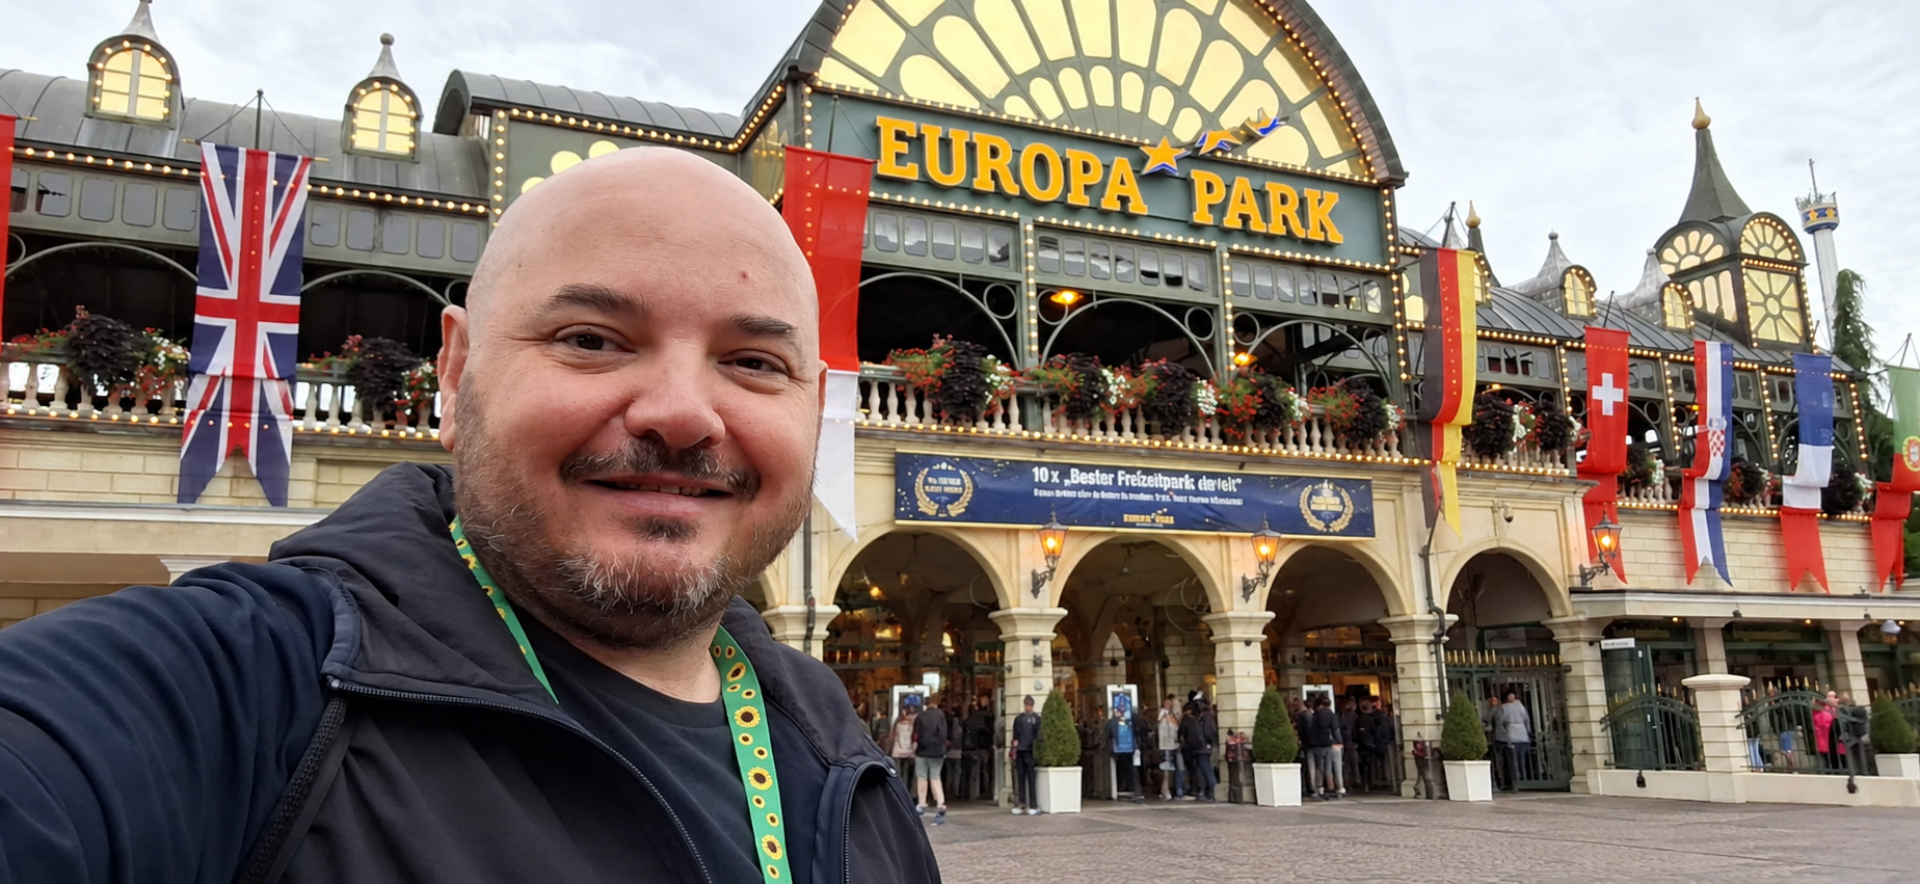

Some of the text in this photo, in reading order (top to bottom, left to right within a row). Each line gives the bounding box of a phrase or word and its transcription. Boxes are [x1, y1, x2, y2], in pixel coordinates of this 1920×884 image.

[875, 115, 1344, 245] EUROPA PARK
[1032, 466, 1049, 483] 10
[1050, 470, 1060, 484] x
[1117, 469, 1195, 491] Freizeitpark
